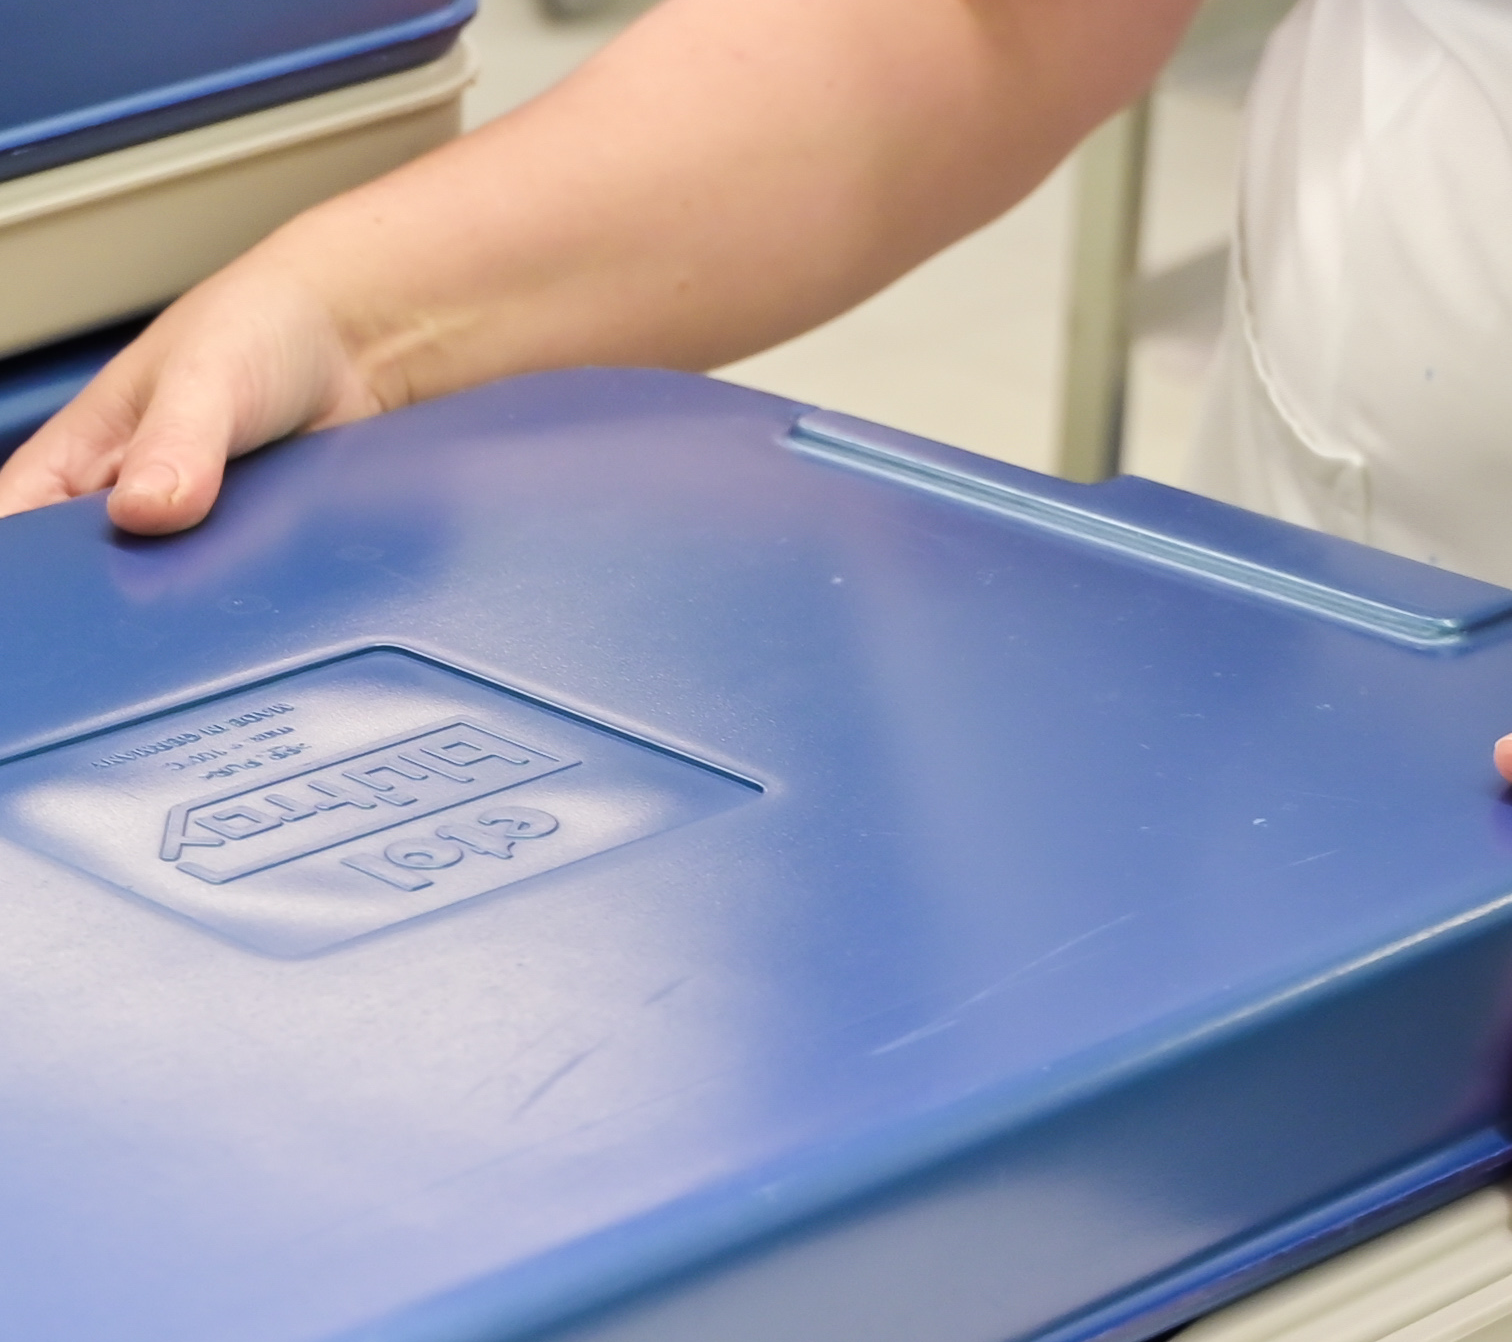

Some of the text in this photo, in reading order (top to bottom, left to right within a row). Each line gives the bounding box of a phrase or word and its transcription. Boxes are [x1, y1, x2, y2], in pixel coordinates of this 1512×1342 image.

[91, 703, 295, 769] MADE IN GERMANY
[340, 806, 561, 892] etol
